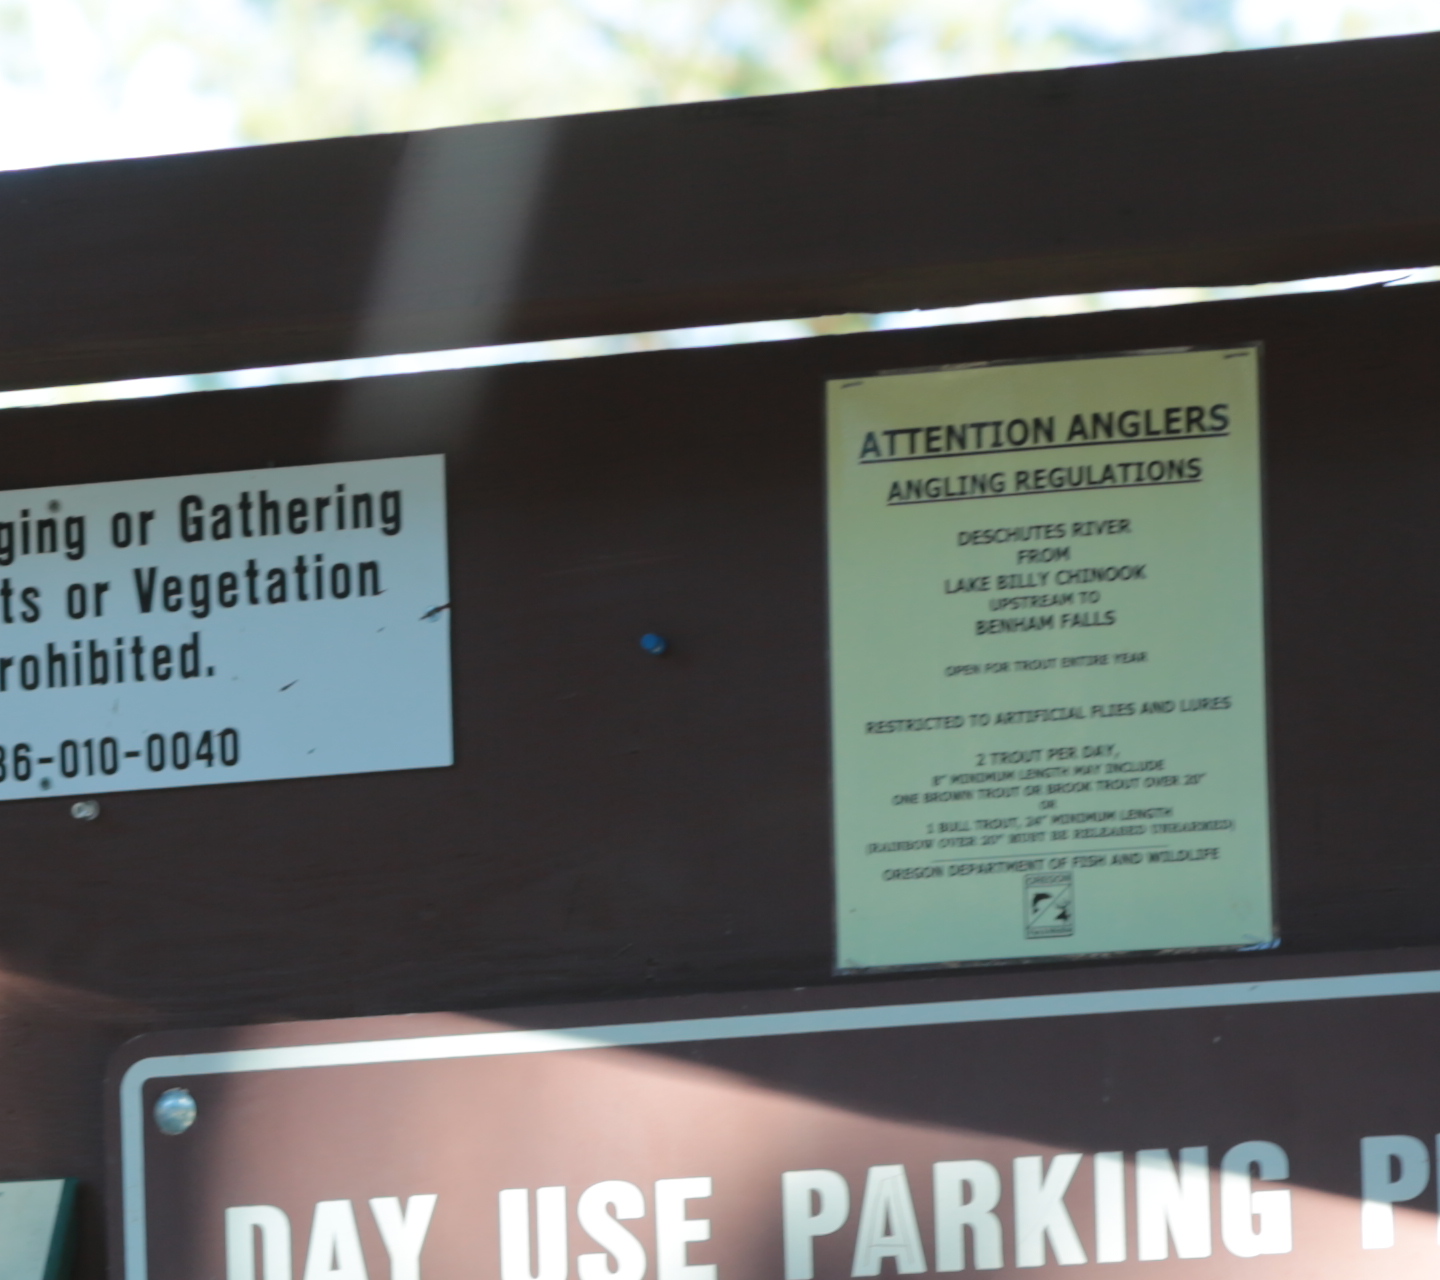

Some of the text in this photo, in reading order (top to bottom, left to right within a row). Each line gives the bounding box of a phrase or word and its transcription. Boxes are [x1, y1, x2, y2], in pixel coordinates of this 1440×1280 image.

[858, 404, 1230, 459] ATTENTION ANGLERS
[888, 457, 1203, 502] ANGLING REGULATIONS
[112, 506, 155, 549] or
[180, 483, 403, 544] Gathering
[957, 519, 1132, 547] DESCHUTES RIVER
[1017, 547, 1071, 566] FROM
[67, 575, 110, 619] or
[133, 553, 383, 619] Vegetation
[944, 564, 1147, 595] LAKE BILLY CHINOOK
[989, 590, 1101, 613] UPSTREAM TO
[975, 610, 1116, 637] BENHAM FALLS
[969, 712, 990, 728] TO
[1139, 699, 1176, 716] AND
